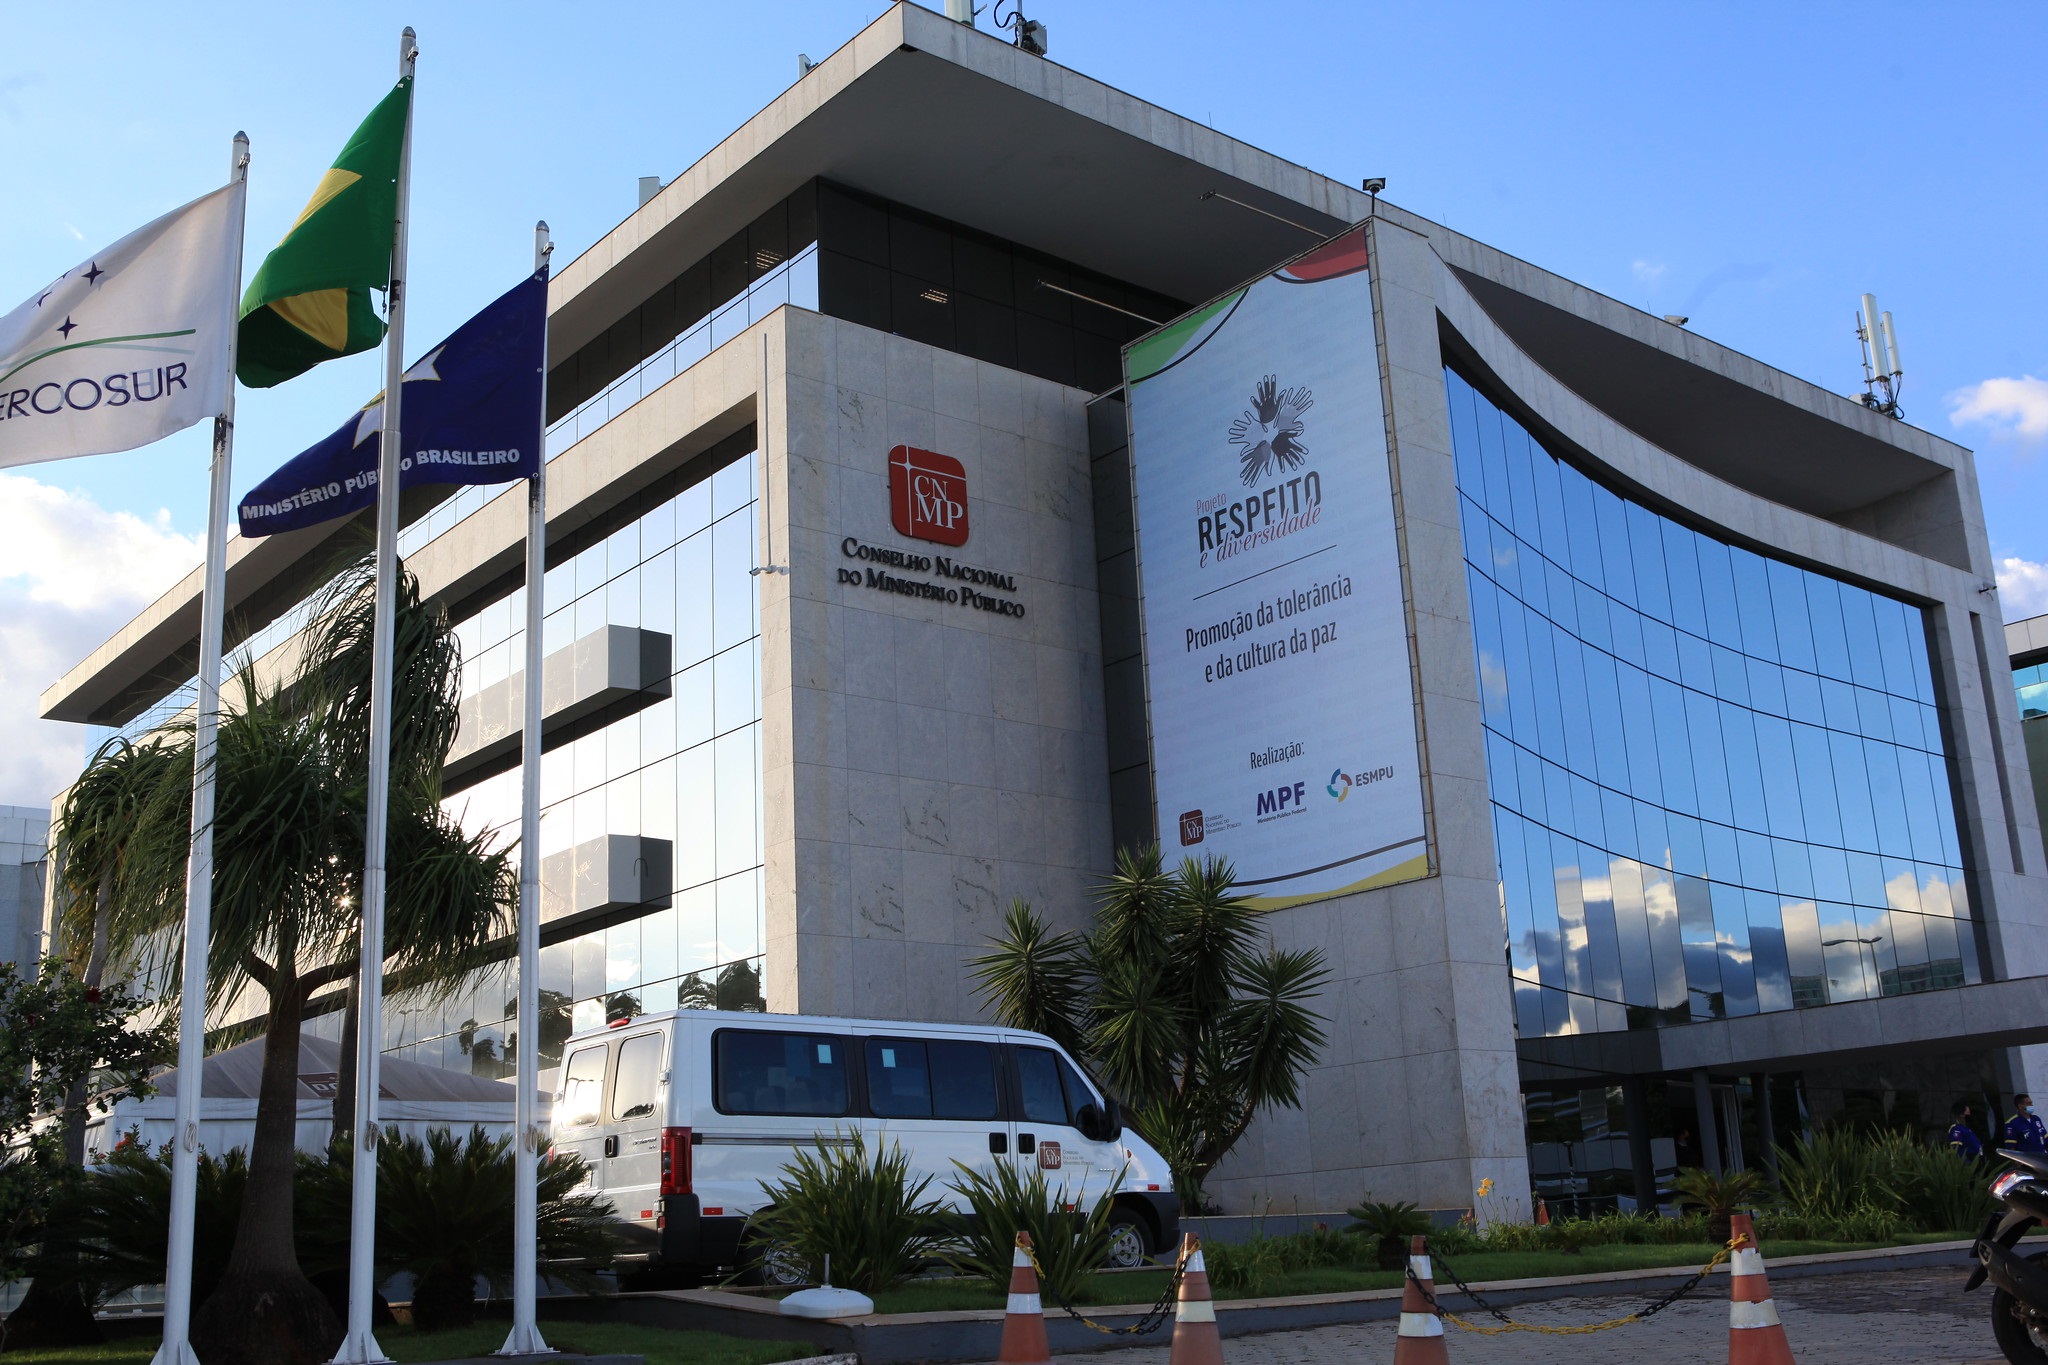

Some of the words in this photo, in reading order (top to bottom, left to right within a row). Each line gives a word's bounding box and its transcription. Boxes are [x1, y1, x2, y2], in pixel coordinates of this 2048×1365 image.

[241, 481, 341, 520] MINISTÉRIO
[345, 457, 413, 495] PÚBO
[416, 448, 521, 466] BRASILEIRO
[914, 475, 948, 501] CN
[1196, 492, 1227, 516] Projeto
[915, 493, 964, 530] MP
[1198, 471, 1322, 553] RESPEITO
[1199, 552, 1208, 569] e
[1216, 498, 1321, 562] diversidade
[841, 537, 931, 571] CONSELHO
[935, 555, 1018, 592] NACIONAL
[1186, 611, 1253, 652] Promoção
[1256, 601, 1274, 627] da
[1277, 574, 1352, 620] tolerância
[1205, 664, 1213, 683] e
[1216, 653, 1233, 679] da
[1236, 642, 1286, 673] cultura
[1289, 627, 1308, 655] da
[1311, 621, 1338, 653] paz
[1250, 741, 1305, 770] Realização:
[1355, 765, 1394, 787] ESMPU
[1256, 781, 1305, 816] MPF
